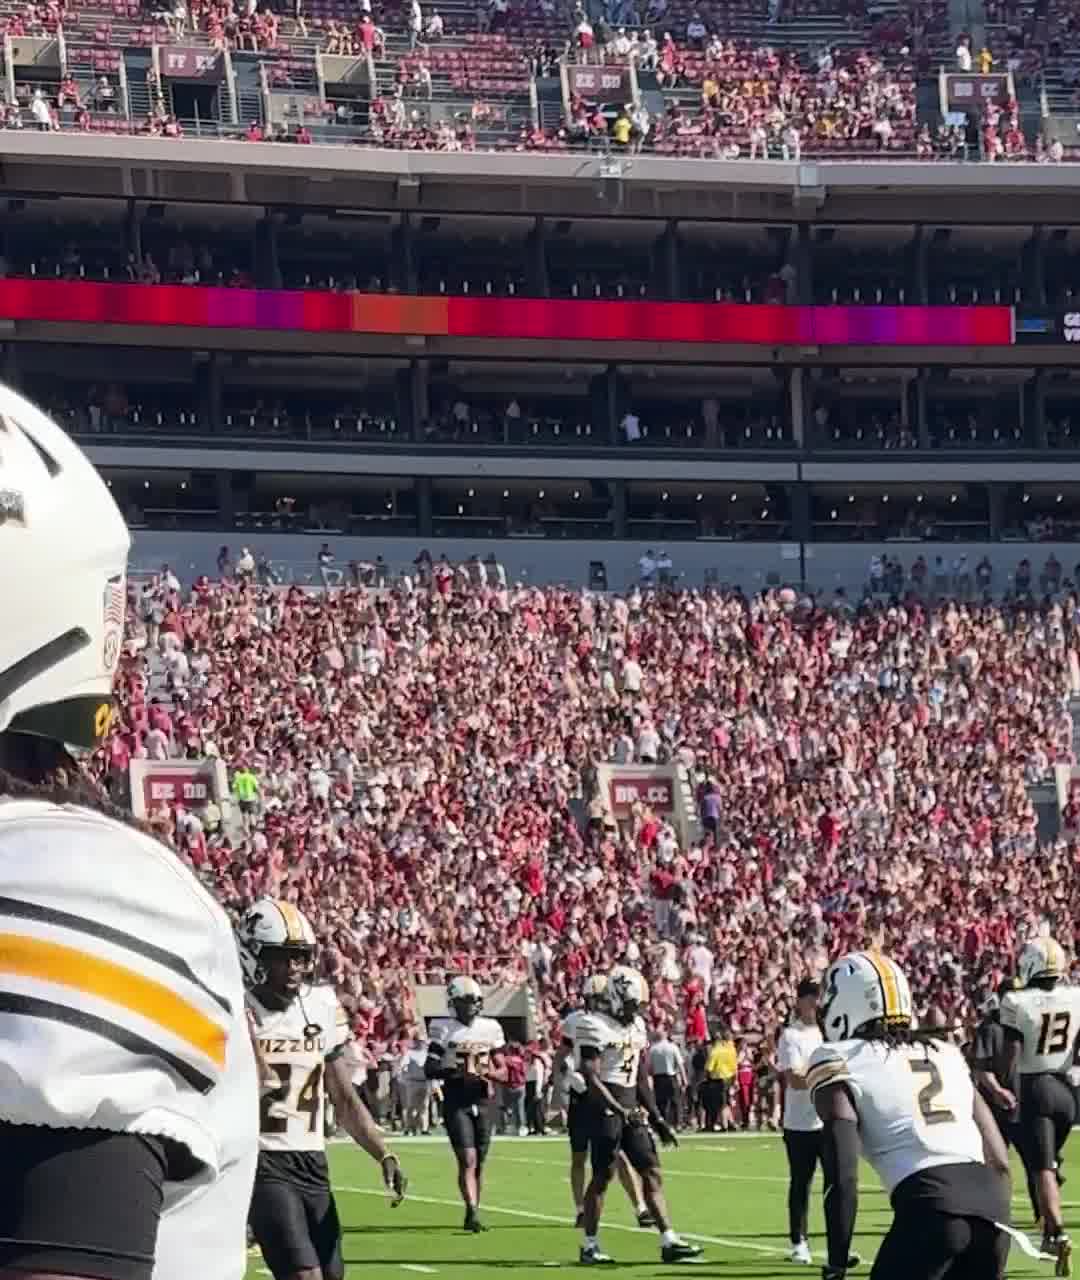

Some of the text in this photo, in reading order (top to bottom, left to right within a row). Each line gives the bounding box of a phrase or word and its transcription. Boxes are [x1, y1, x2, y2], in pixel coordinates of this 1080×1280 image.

[1036, 1012, 1071, 1055] 13
[260, 1063, 322, 1133] 24
[908, 1058, 958, 1127] 2
